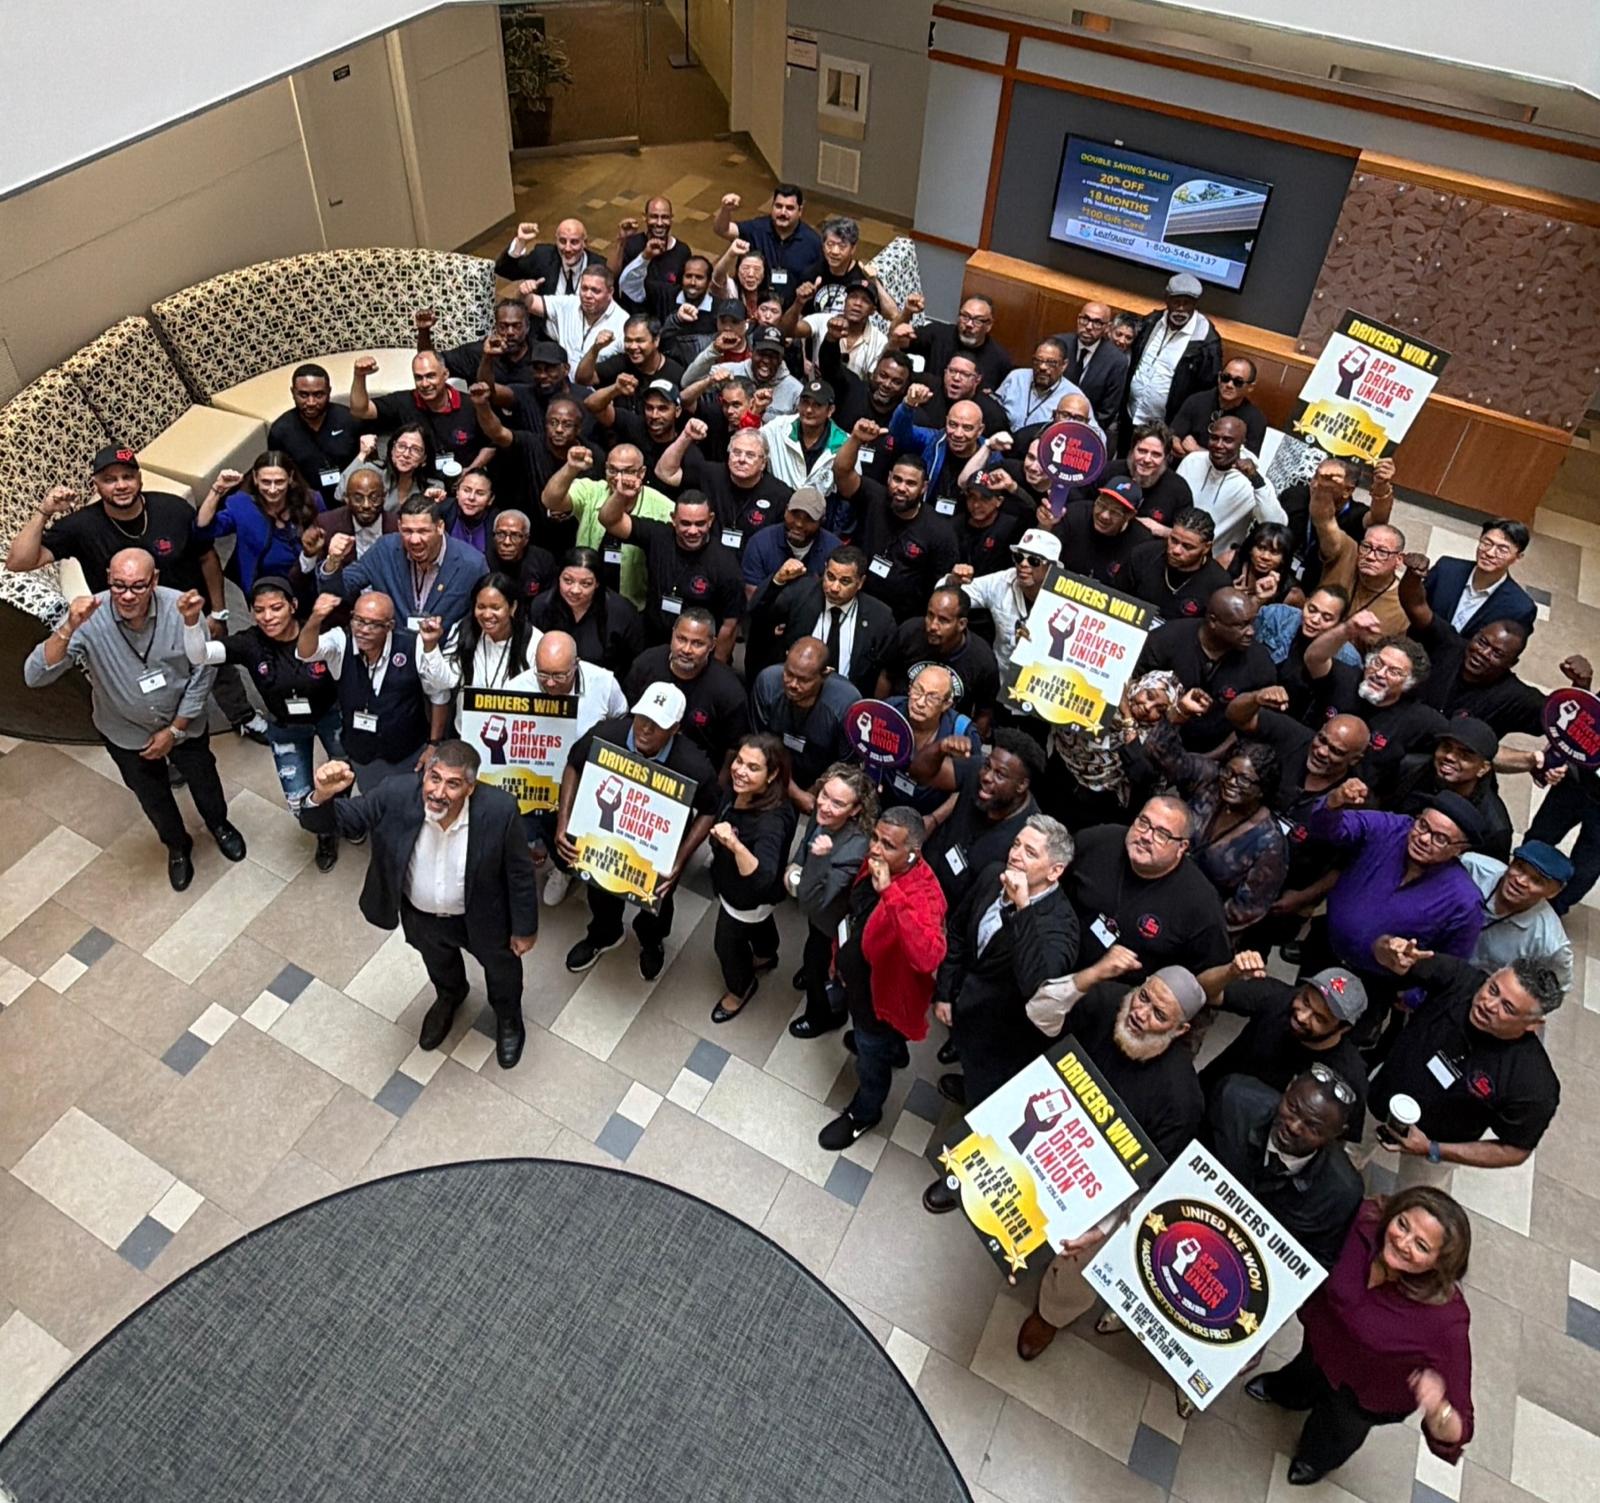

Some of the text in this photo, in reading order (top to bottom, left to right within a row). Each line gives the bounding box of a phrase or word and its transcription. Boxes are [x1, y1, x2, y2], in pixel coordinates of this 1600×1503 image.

[1081, 153, 1111, 167] DOUBLE
[1113, 161, 1146, 175] SAVINGS
[1122, 179, 1144, 191] OFF
[1089, 190, 1149, 213] 18 MONTHS
[1104, 213, 1121, 224] Gift
[1123, 219, 1144, 230] Card
[1347, 319, 1402, 354] DRIVERS
[1400, 342, 1429, 367] WIN
[1370, 358, 1396, 375] APP
[1357, 383, 1394, 409] UNION
[1363, 373, 1414, 402] DRIVERS
[1063, 453, 1090, 473] UNION
[1053, 575, 1108, 610] DRIVERS
[1109, 597, 1137, 622] WIN
[1080, 615, 1106, 634] APP
[1069, 643, 1107, 669] UNION
[1075, 630, 1126, 660] DRIVERS
[1030, 675, 1095, 710] DRIVERS UNION
[1051, 675, 1076, 691] FIRST
[474, 694, 530, 712] DRIVERS
[533, 698, 559, 713] WIN
[1026, 684, 1093, 718] IN THE NATION
[511, 733, 562, 748] DRIVERS
[512, 720, 536, 733] APP
[510, 745, 547, 760] UNION
[871, 733, 899, 754] UNION
[597, 748, 650, 782] DRIVERS
[651, 770, 678, 795] WIN
[626, 788, 650, 807] APP
[618, 815, 654, 841] UNION
[622, 802, 671, 834] DRIVERS
[584, 845, 648, 881] DRIVERS UNION
[605, 845, 628, 862] FIRST
[582, 854, 646, 888] IN THE NATION
[1056, 1051, 1115, 1124] DRIVERS
[1105, 1117, 1142, 1162] WIN
[1063, 1118, 1095, 1152] APP
[1033, 1141, 1076, 1197] UNION
[1048, 1129, 1103, 1199] DRIVERS
[969, 1149, 1034, 1237] DRIVERS UNION
[996, 1166, 1023, 1198] FIRST
[961, 1156, 1024, 1245] IN THE NATION
[1187, 1154, 1312, 1280] APP DRIVERS UNION
[1181, 1205, 1262, 1291] UNITED WE WON
[1200, 1252, 1219, 1270] APP
[1092, 1264, 1112, 1286] IAM
[1142, 1238, 1175, 1313] MASSACHUSETTS
[1174, 1311, 1208, 1338] DRIVERS
[1209, 1328, 1232, 1340] FIRST
[1184, 1269, 1222, 1309] UNION
[1115, 1279, 1140, 1307] FIRST
[1135, 1301, 1171, 1342] DRIVERS
[1168, 1336, 1194, 1368] UNION
[1120, 1300, 1175, 1361] IN THE NATION
